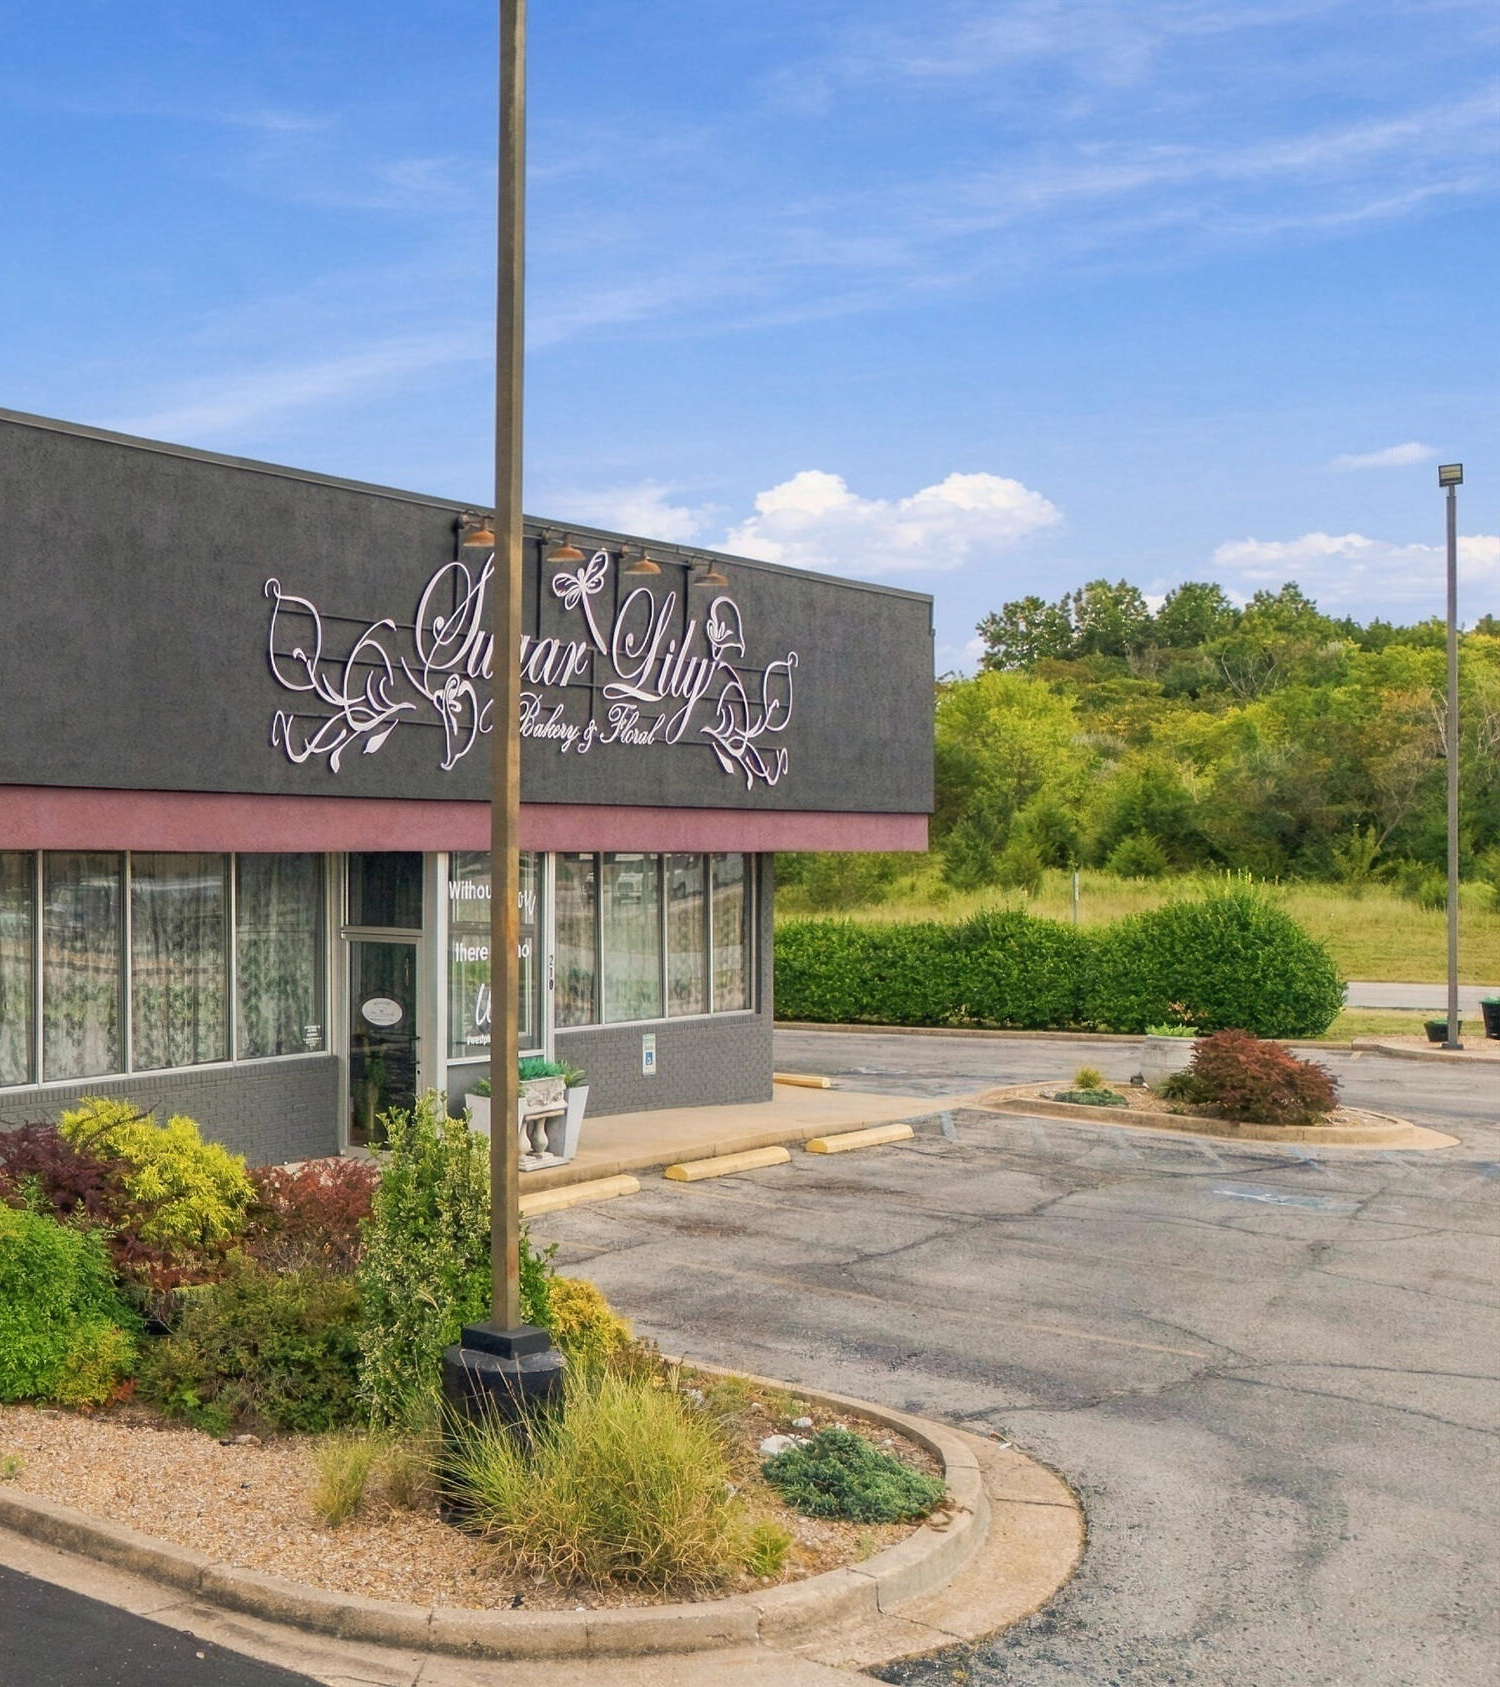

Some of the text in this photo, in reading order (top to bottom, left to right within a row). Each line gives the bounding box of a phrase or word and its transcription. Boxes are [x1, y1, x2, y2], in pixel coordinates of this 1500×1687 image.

[603, 587, 716, 745] Lily
[519, 692, 666, 754] Bakery & Floral
[449, 880, 491, 900] Withou
[455, 943, 488, 962] there
